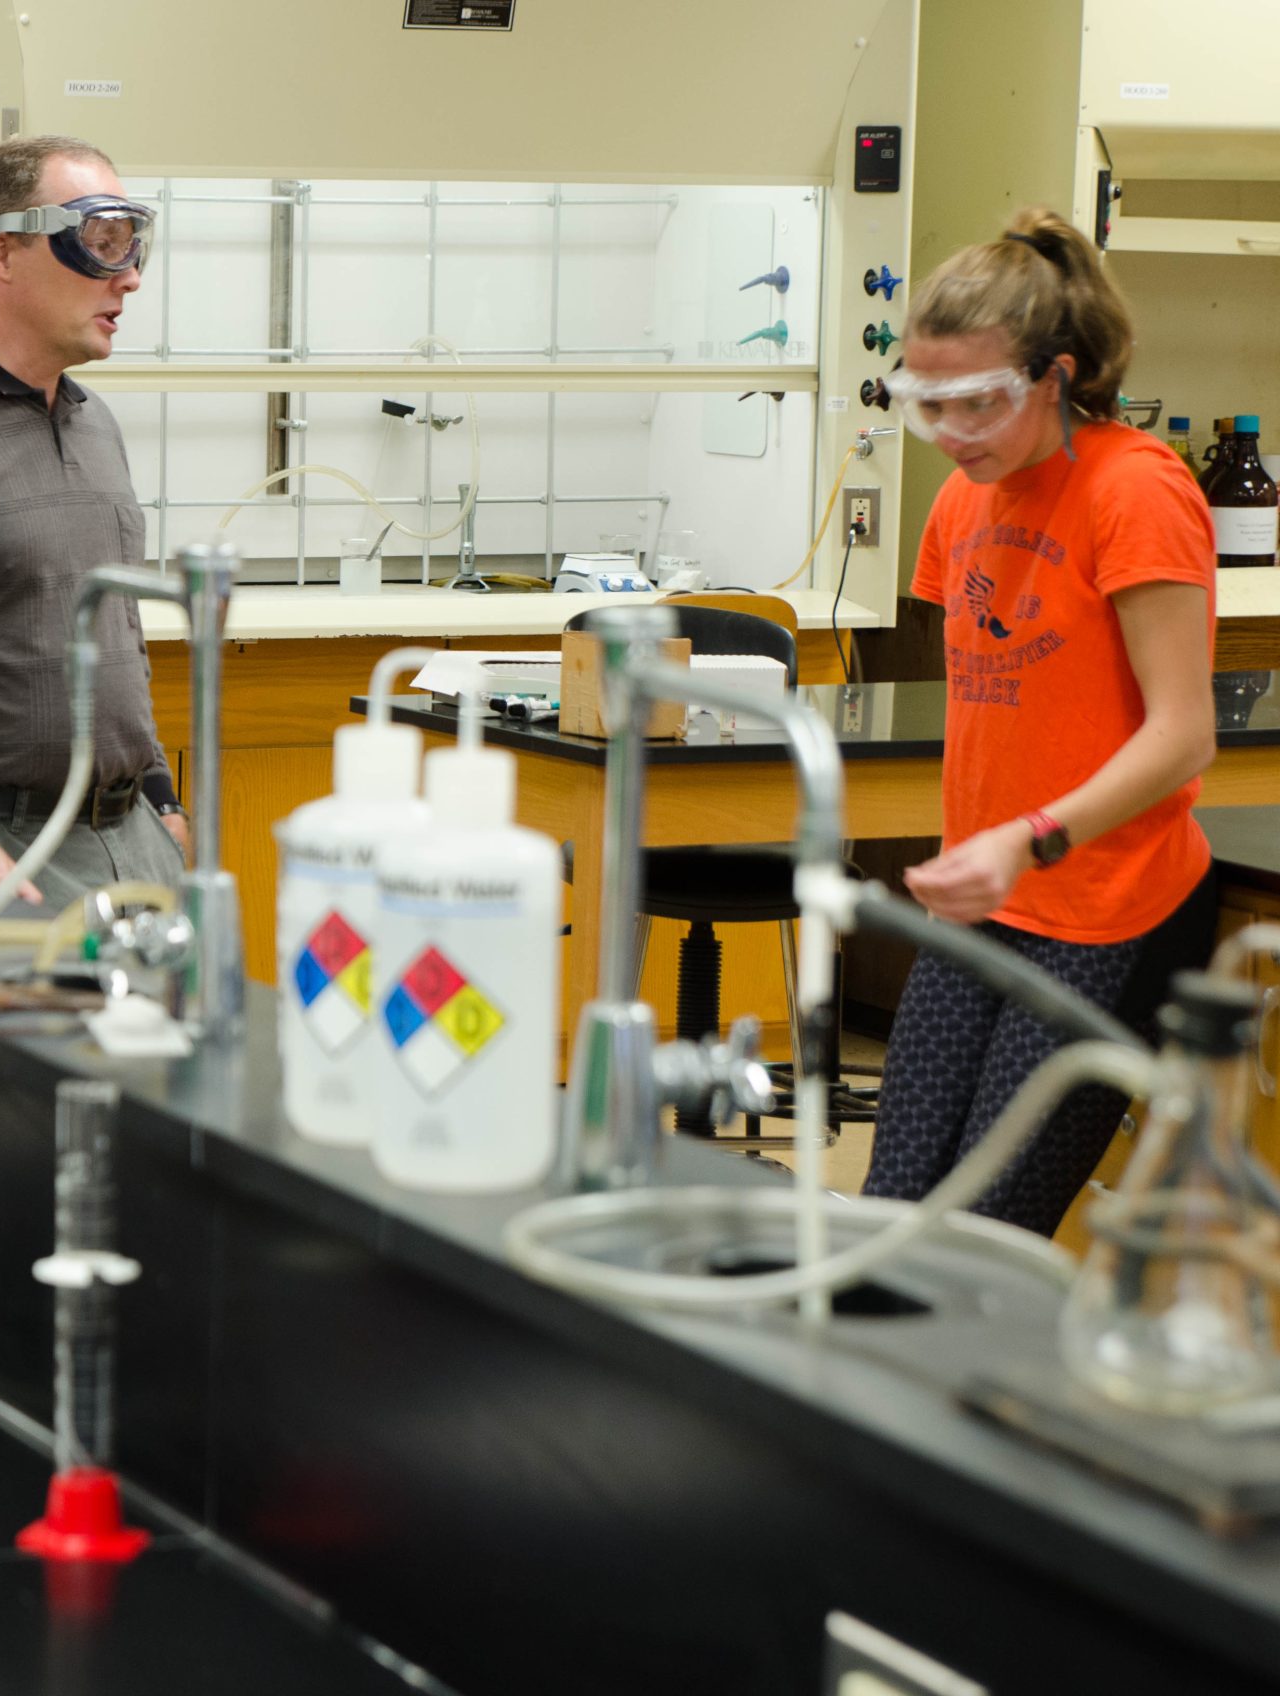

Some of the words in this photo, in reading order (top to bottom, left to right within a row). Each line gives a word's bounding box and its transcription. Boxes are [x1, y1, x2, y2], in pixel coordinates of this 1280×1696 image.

[68, 82, 96, 92] HOOD
[97, 83, 120, 93] 2-260
[951, 674, 1021, 706] TRACK
